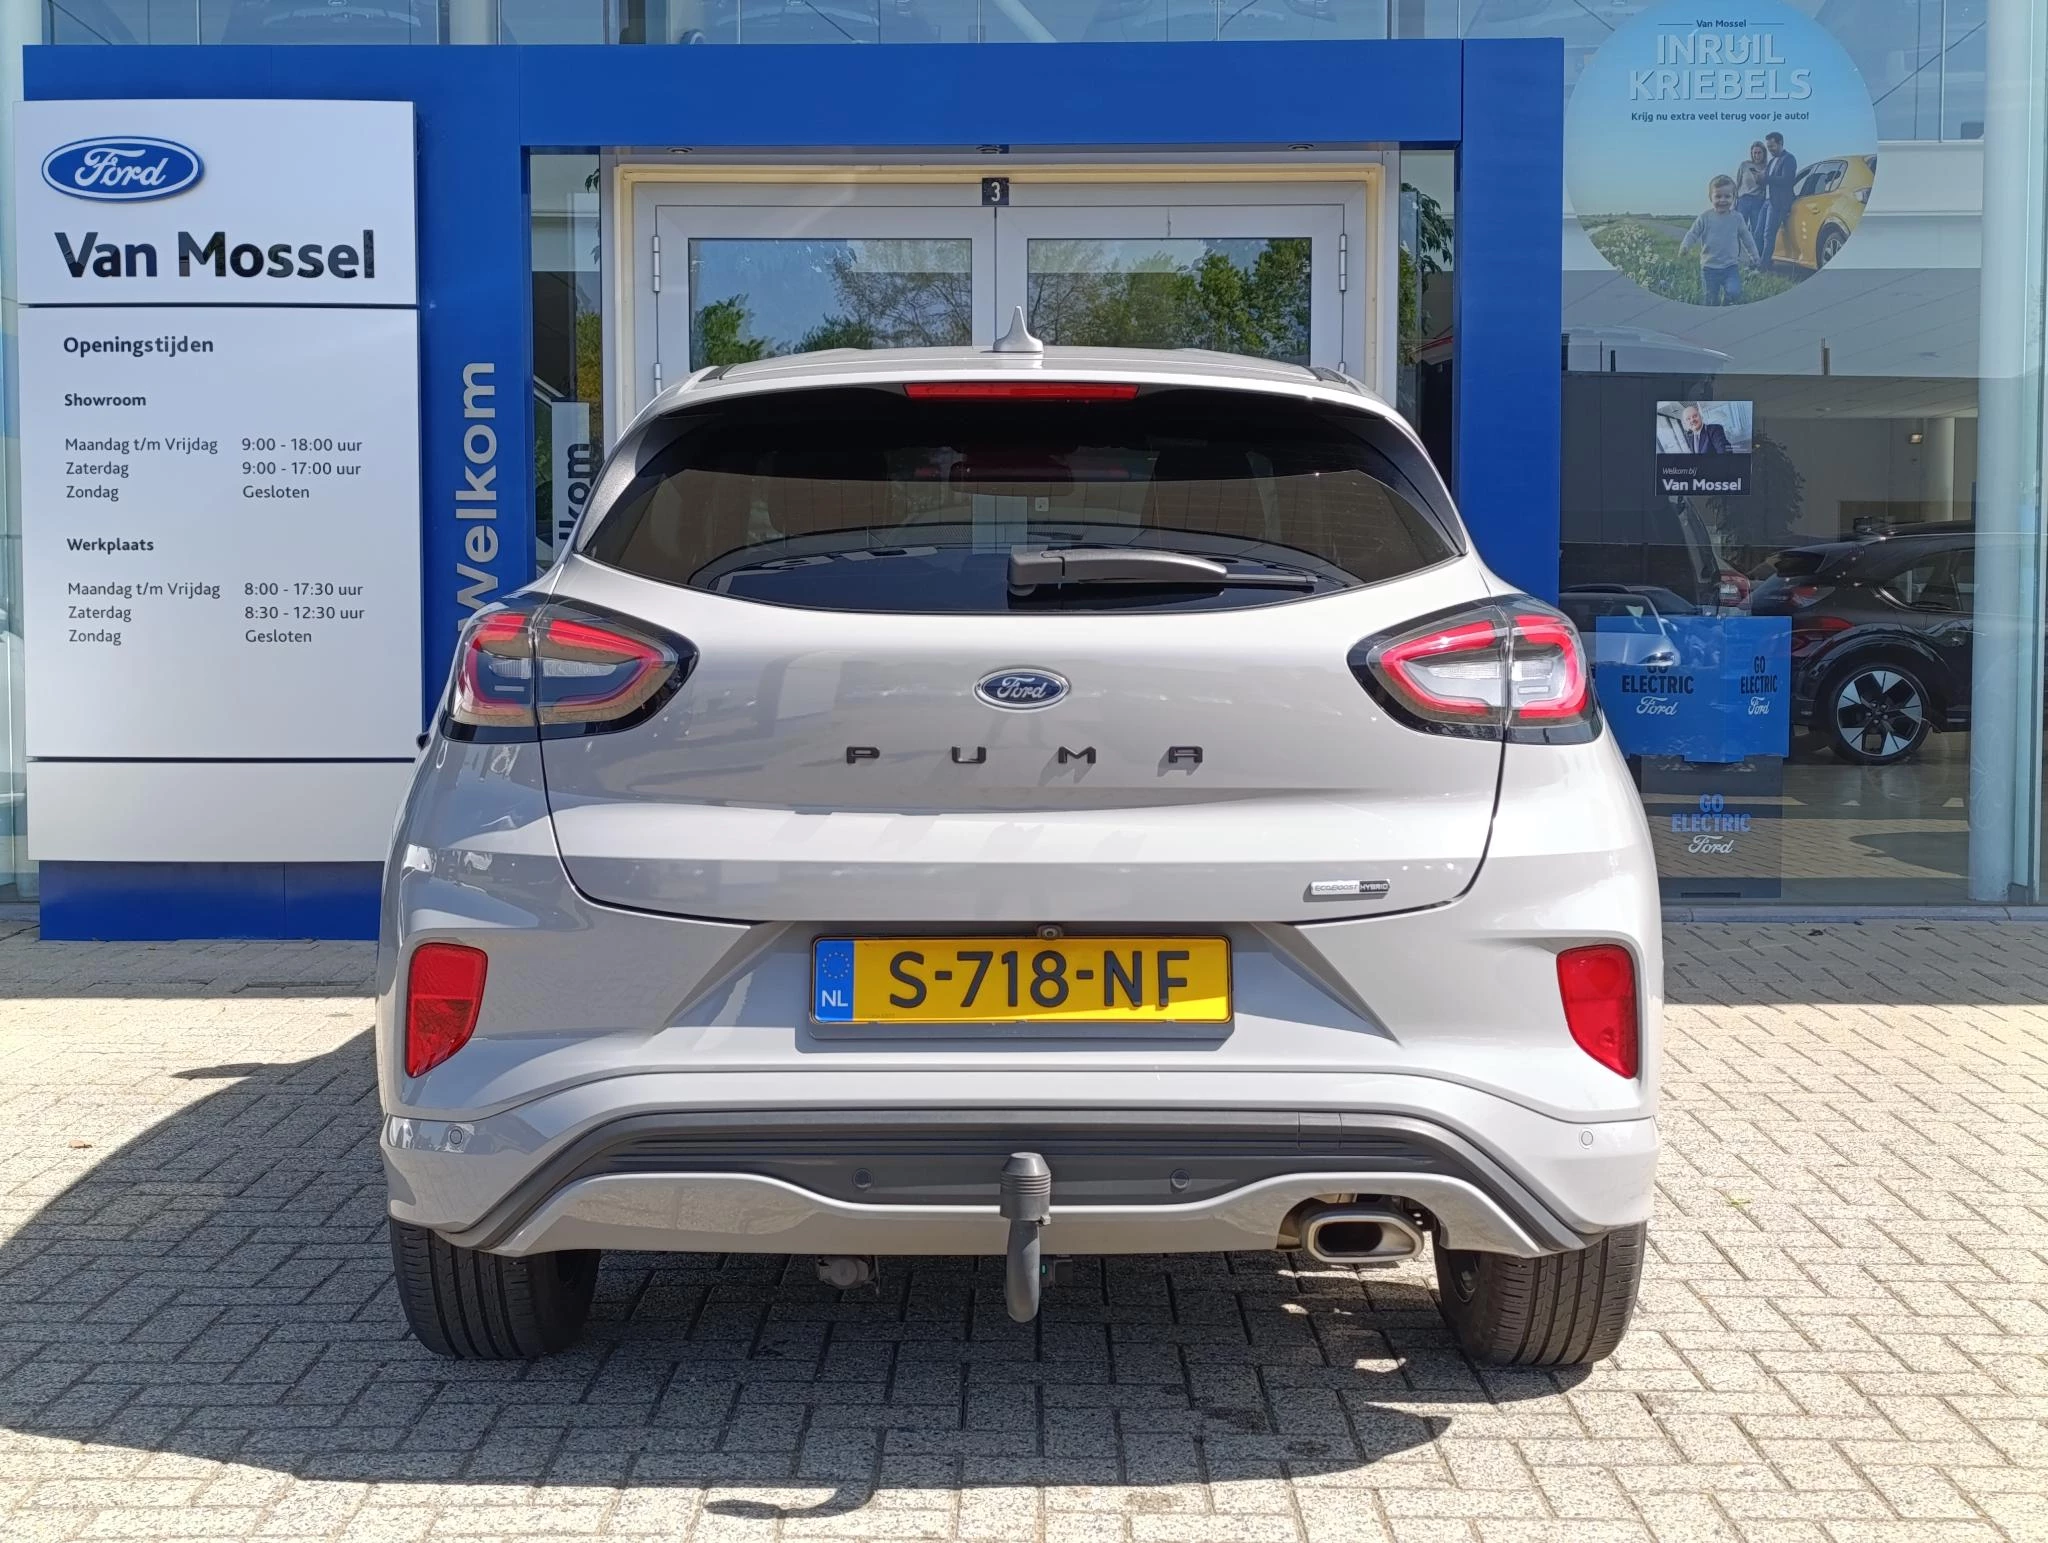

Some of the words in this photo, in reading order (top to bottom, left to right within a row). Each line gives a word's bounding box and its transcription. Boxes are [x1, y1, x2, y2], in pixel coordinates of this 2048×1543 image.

[1696, 19, 1713, 28] Van
[1715, 19, 1747, 28] Mossel
[1657, 32, 1786, 65] INRUIL
[1629, 68, 1812, 101] KRIEBELS
[1631, 112, 1654, 122] Krijg
[1656, 113, 1668, 121] nu
[1670, 112, 1696, 121] extra
[1698, 111, 1719, 121] veel
[1720, 112, 1747, 123] terug
[1749, 112, 1771, 121] voor
[1772, 111, 1783, 122] je
[1784, 111, 1810, 121] auto!
[74, 147, 169, 187] Ford
[991, 181, 1001, 202] 3
[54, 231, 158, 279] Van
[177, 229, 375, 279] Mossel
[63, 336, 214, 358] Openingstijden
[64, 393, 147, 407] Showroom
[65, 437, 130, 455] Maandag
[133, 437, 161, 453] t/m
[164, 437, 219, 455] Vrijdag
[241, 438, 276, 452] 9:00
[290, 438, 333, 452] 18:00
[337, 440, 363, 452] uur
[65, 461, 130, 478] Zaterdag
[242, 461, 277, 476] 9:00
[291, 461, 332, 476] 17:00
[336, 464, 362, 476] uur
[1662, 467, 1687, 475] Welkom
[65, 485, 120, 502] Zondag
[242, 485, 310, 499] Gesloten
[1662, 478, 1689, 491] Van
[1692, 478, 1742, 491] Mossel
[66, 537, 155, 555] Werkplaats
[68, 582, 133, 600] Maandag
[135, 582, 163, 597] t/m
[167, 582, 221, 600] Vrijdag
[244, 582, 279, 596] 8:00
[293, 582, 335, 596] 17:30
[338, 585, 364, 596] uur
[68, 606, 132, 623] Zaterdag
[244, 606, 279, 620] 8:30
[293, 606, 336, 620] 12:30
[340, 609, 365, 620] uur
[68, 629, 122, 646] Zondag
[245, 629, 312, 643] Gesloten
[1754, 655, 1766, 674] GO
[997, 676, 1048, 698] Ford
[1622, 675, 1694, 694] ELECTRIC
[1740, 674, 1778, 694] ELECTRIC
[1636, 695, 1679, 716] Ford
[1747, 696, 1770, 715] Ford
[1699, 794, 1724, 813] GO
[1671, 813, 1751, 832] ELECTRIC
[1688, 834, 1734, 854] Ford
[1360, 883, 1388, 891] HYBRID
[889, 949, 1191, 1011] S-718-NF
[821, 989, 849, 1008] NL
